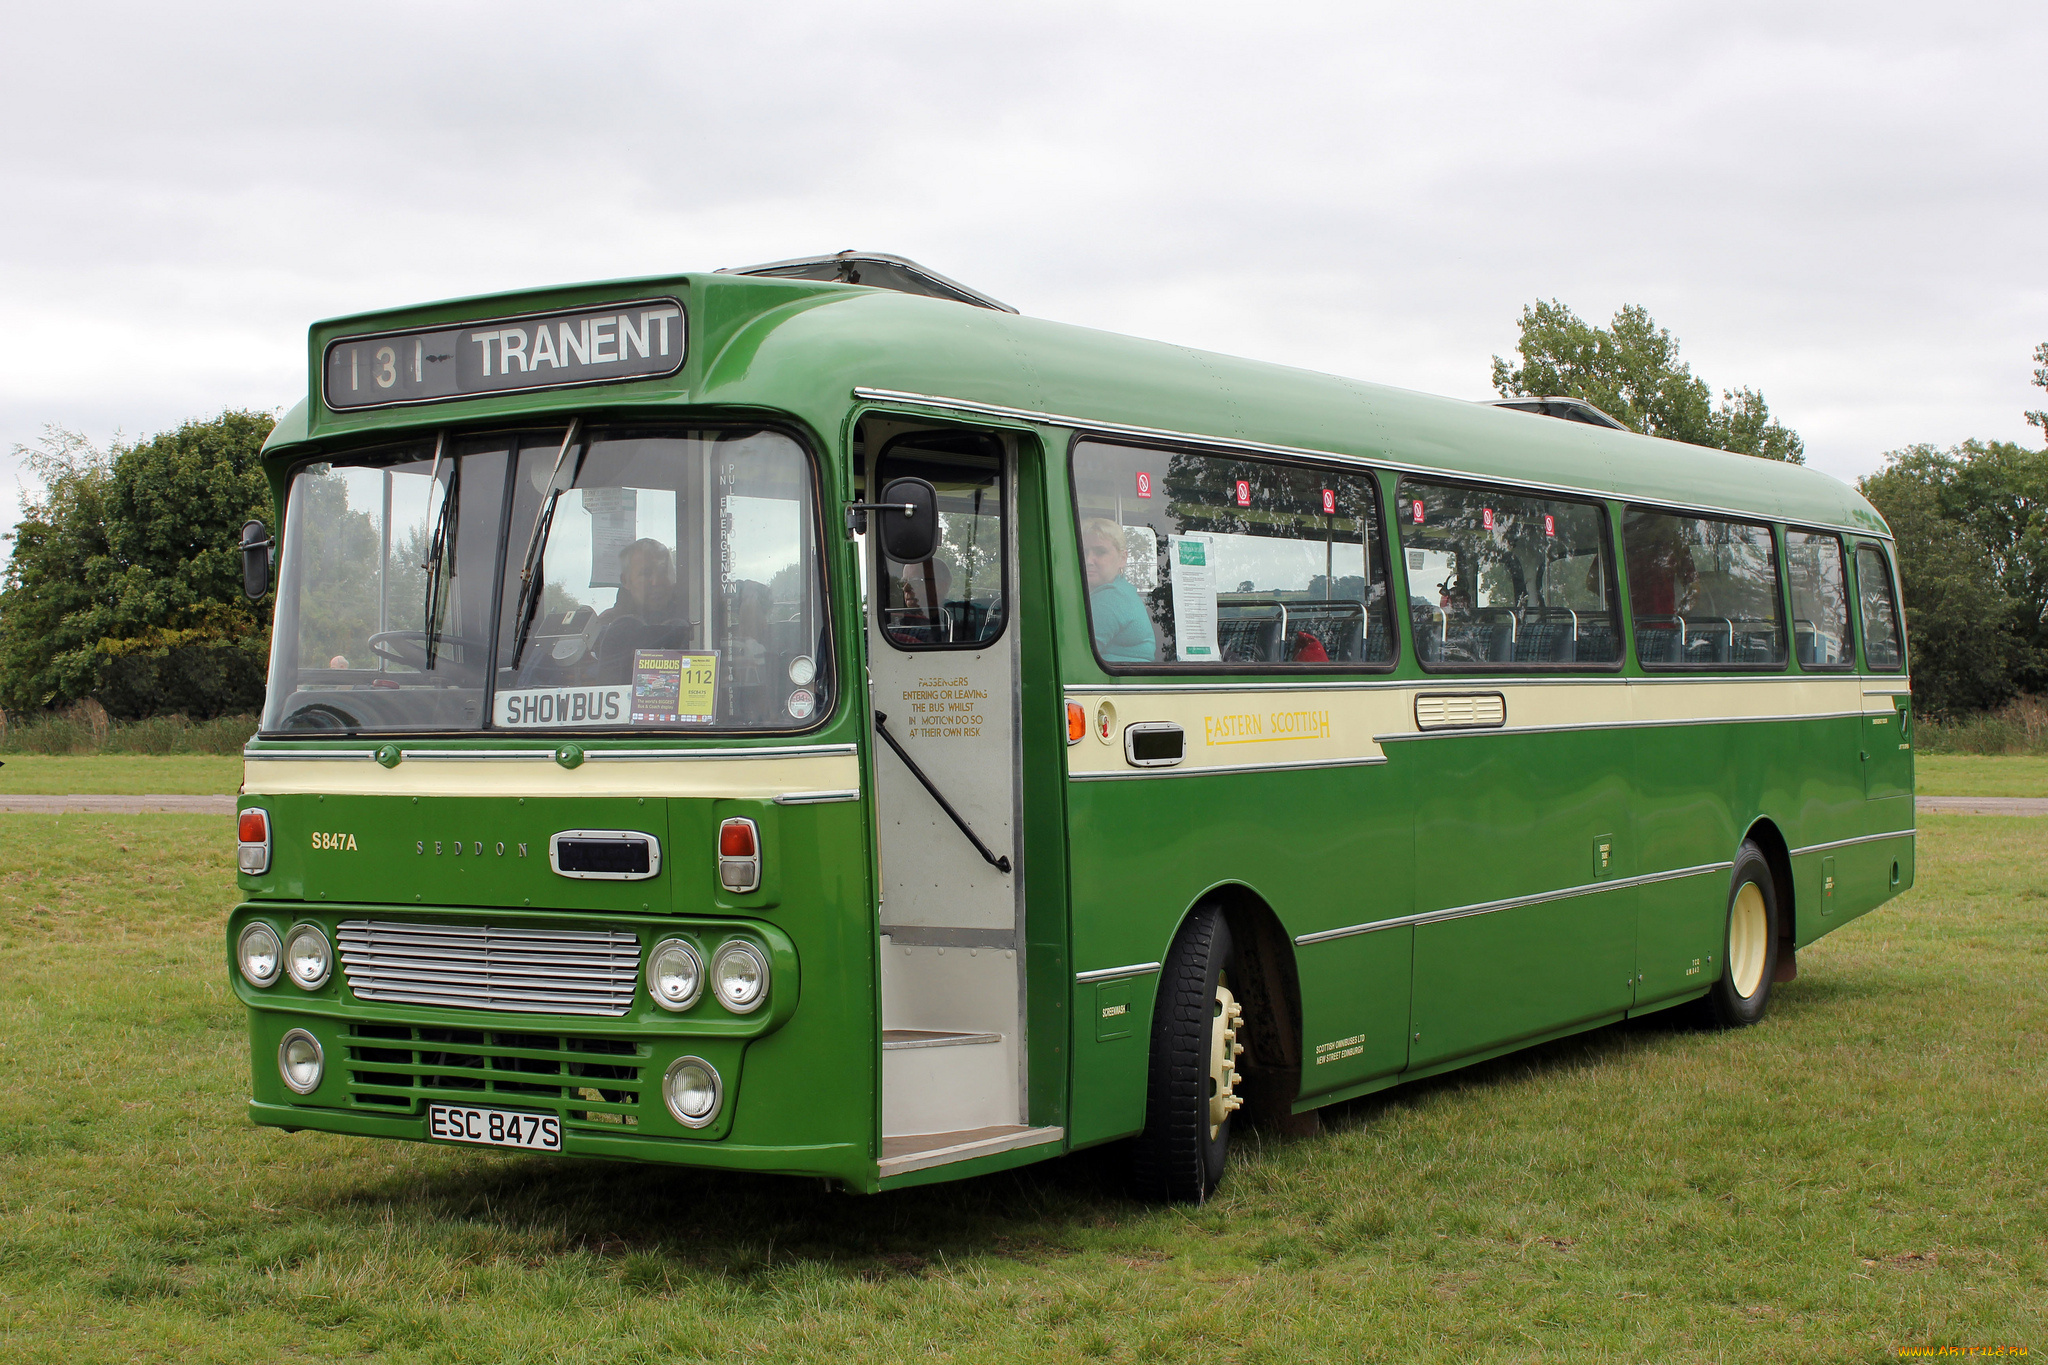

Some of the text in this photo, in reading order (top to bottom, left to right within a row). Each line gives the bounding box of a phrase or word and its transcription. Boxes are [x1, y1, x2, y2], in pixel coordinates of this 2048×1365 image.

[351, 308, 679, 391] 131 TRANENT
[720, 465, 726, 485] IN
[719, 497, 728, 593] EMERGENCY
[639, 660, 679, 669] SHOWBUS
[686, 669, 712, 684] 112
[918, 677, 969, 687] PASSENGERS
[902, 689, 988, 700] ENTERING OR LEAVING
[507, 691, 620, 724] SHOWBUS
[911, 702, 974, 712] THE BUS WHILST
[908, 714, 984, 725] IN MOTION DO SO
[909, 727, 981, 738] AT THEIR OWN RISK
[1204, 710, 1330, 746] EASTERN SCOTTISH
[311, 832, 358, 851] S847A
[416, 841, 528, 857] SEDDON
[1316, 1041, 1335, 1054] SCOTTISH
[1326, 1050, 1341, 1063] STREET
[431, 1107, 559, 1147] ESC 847S
